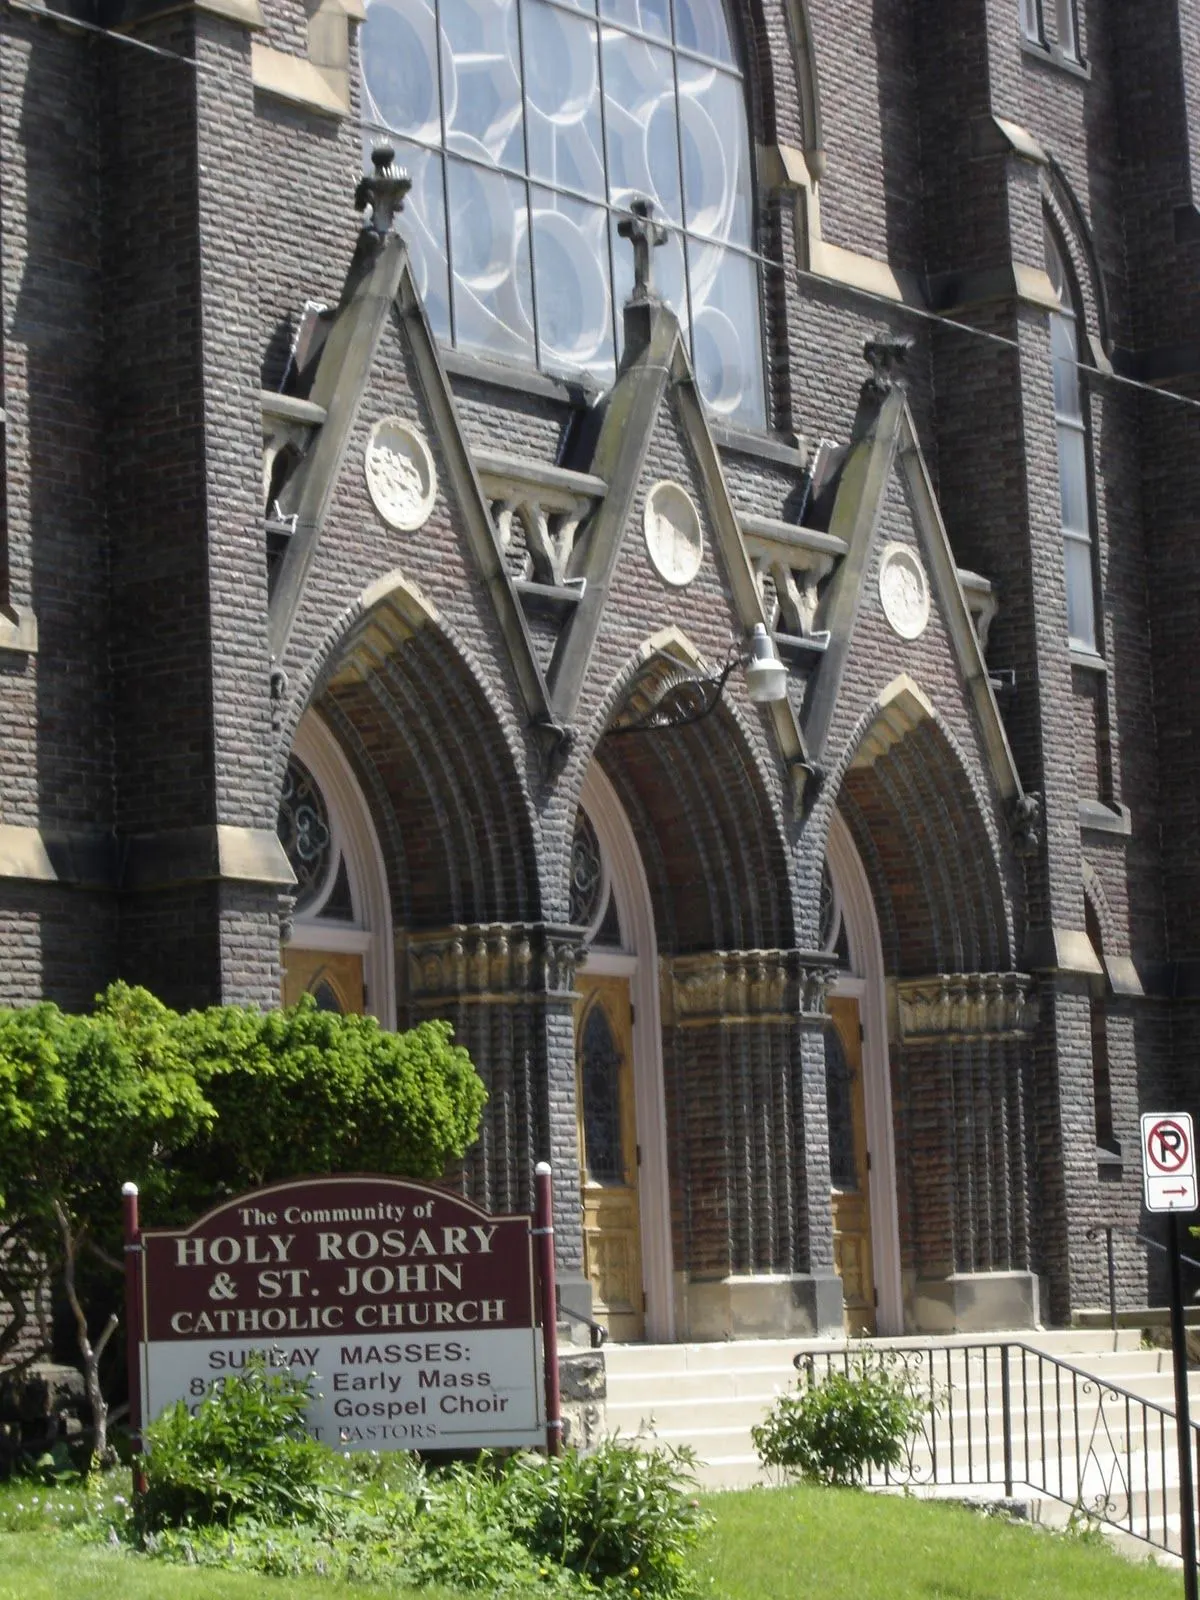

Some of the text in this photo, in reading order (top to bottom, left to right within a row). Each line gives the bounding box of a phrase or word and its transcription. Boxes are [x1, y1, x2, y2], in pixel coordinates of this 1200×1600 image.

[238, 1200, 435, 1227] The Community of
[174, 1225, 499, 1267] HOLY ROSARY
[208, 1262, 464, 1300] & ST. JOHN
[170, 1299, 506, 1335] CATHOLIC CHURCH
[340, 1342, 471, 1366] MASSES:
[333, 1371, 401, 1394] Early
[419, 1370, 491, 1389] Mass
[334, 1394, 509, 1421] Gospel Choir
[338, 1424, 437, 1441] PASTORS
